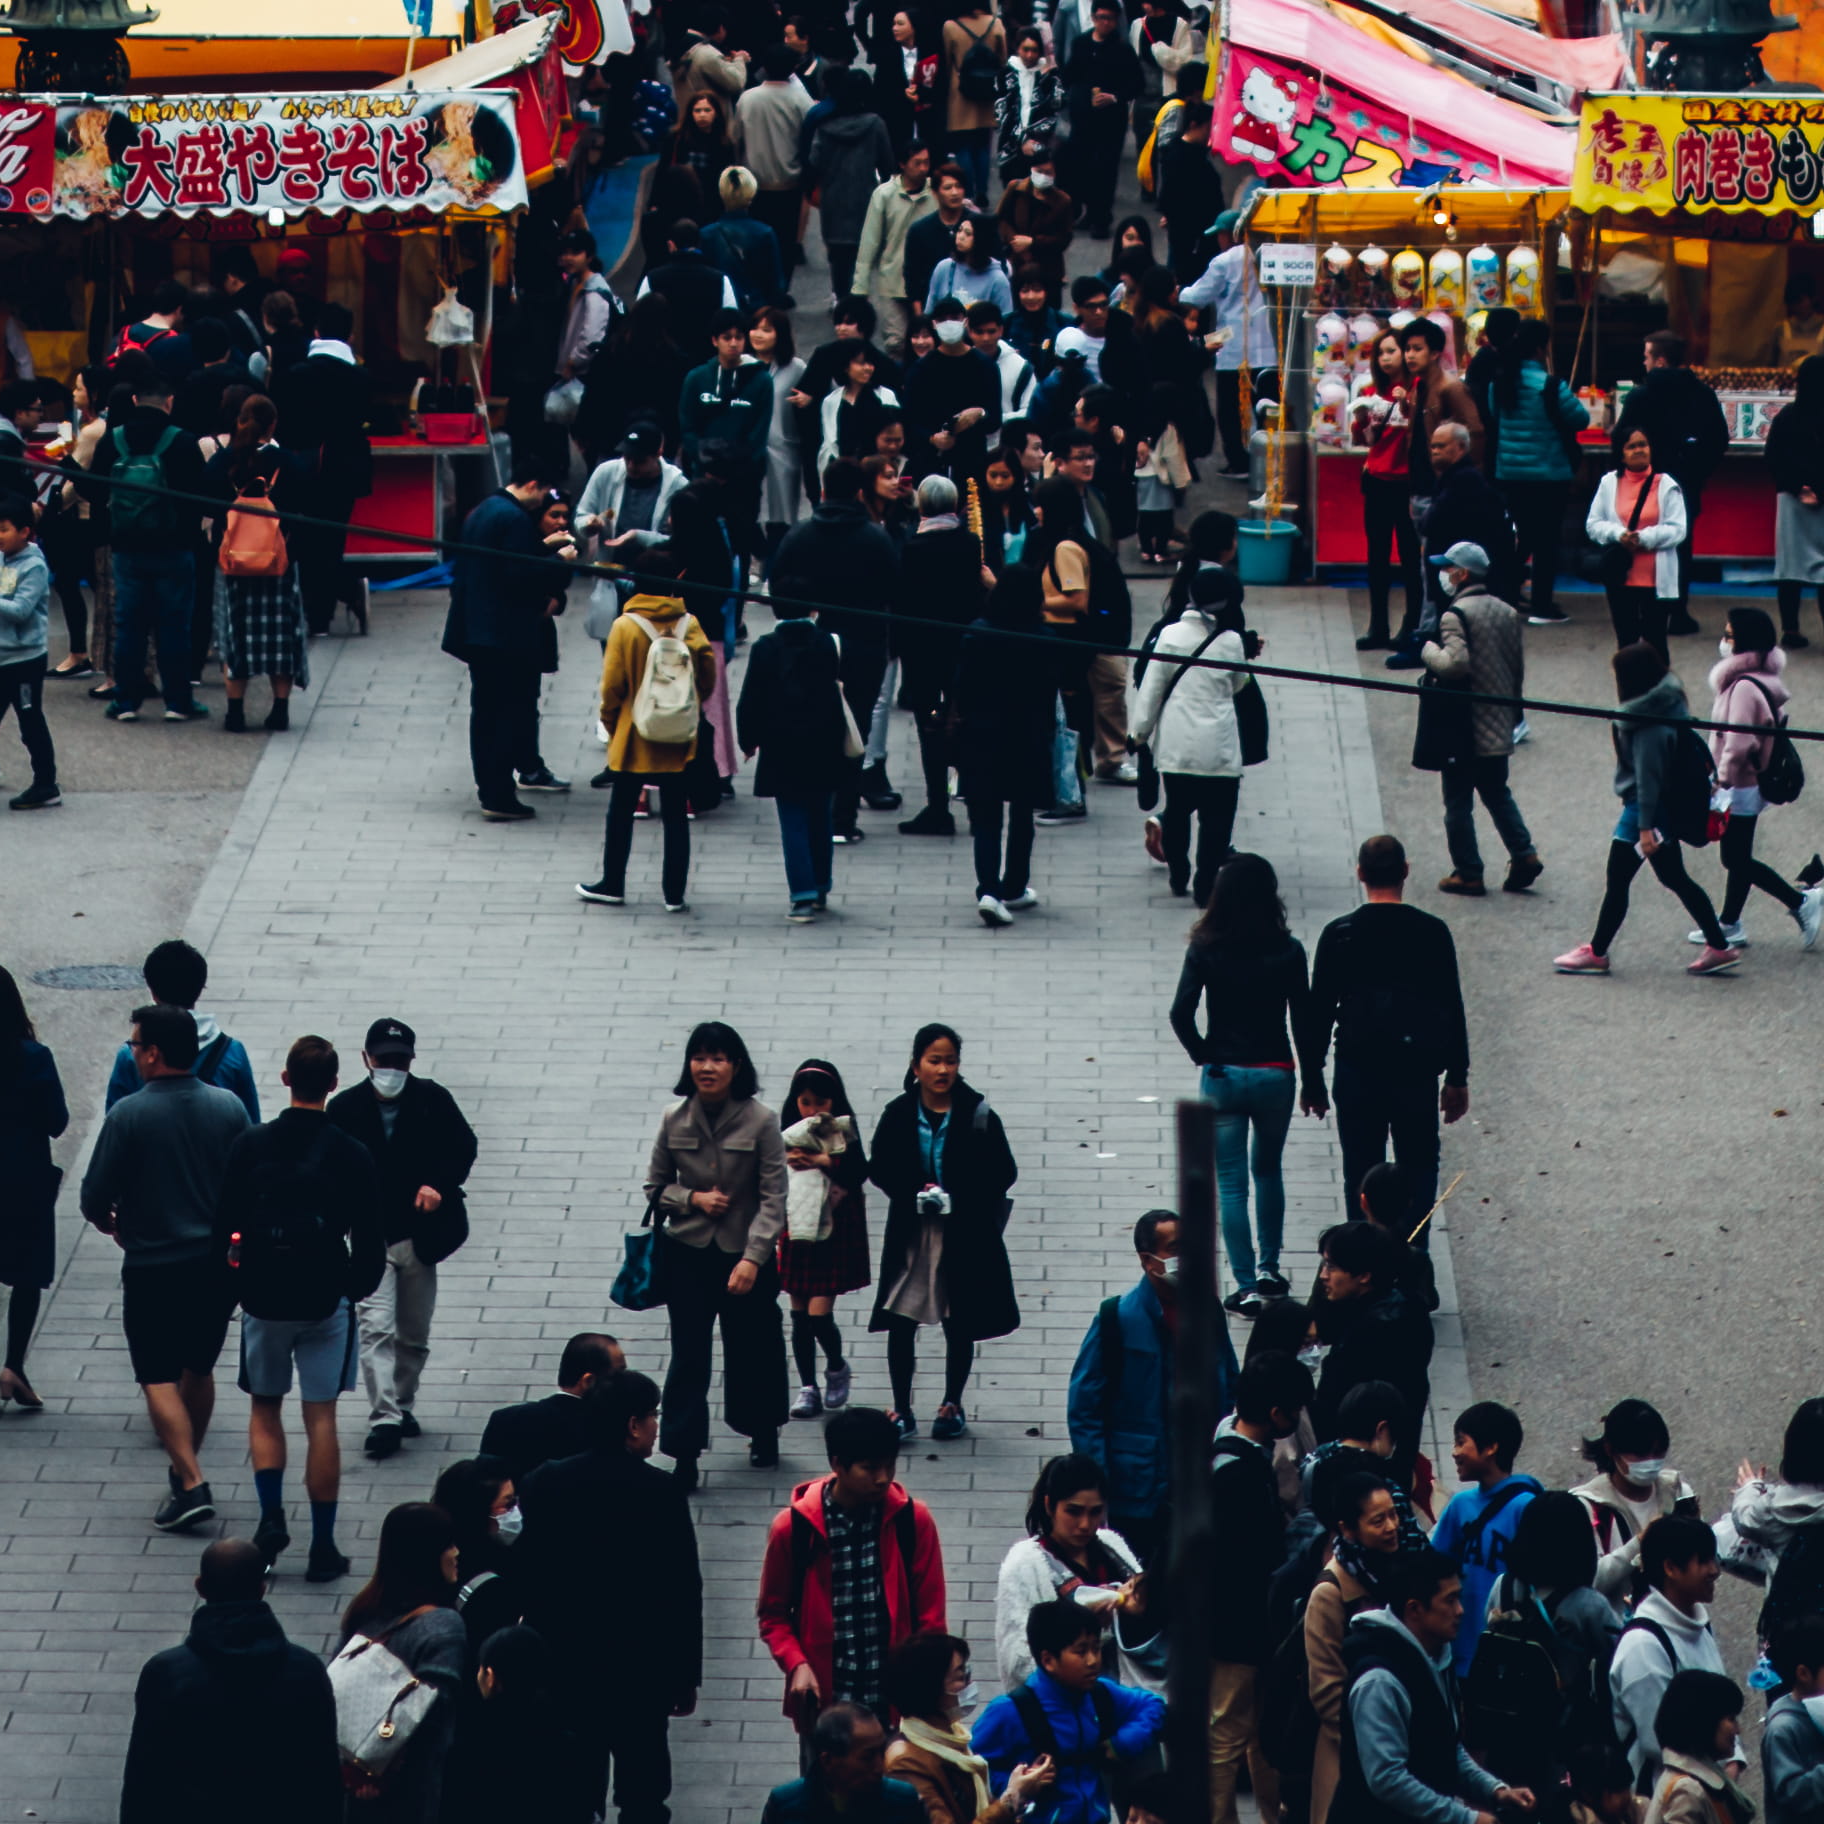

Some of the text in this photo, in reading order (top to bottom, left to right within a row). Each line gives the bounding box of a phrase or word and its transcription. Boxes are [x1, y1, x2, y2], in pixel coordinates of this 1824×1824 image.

[122, 118, 432, 207] 大盛やきそば
